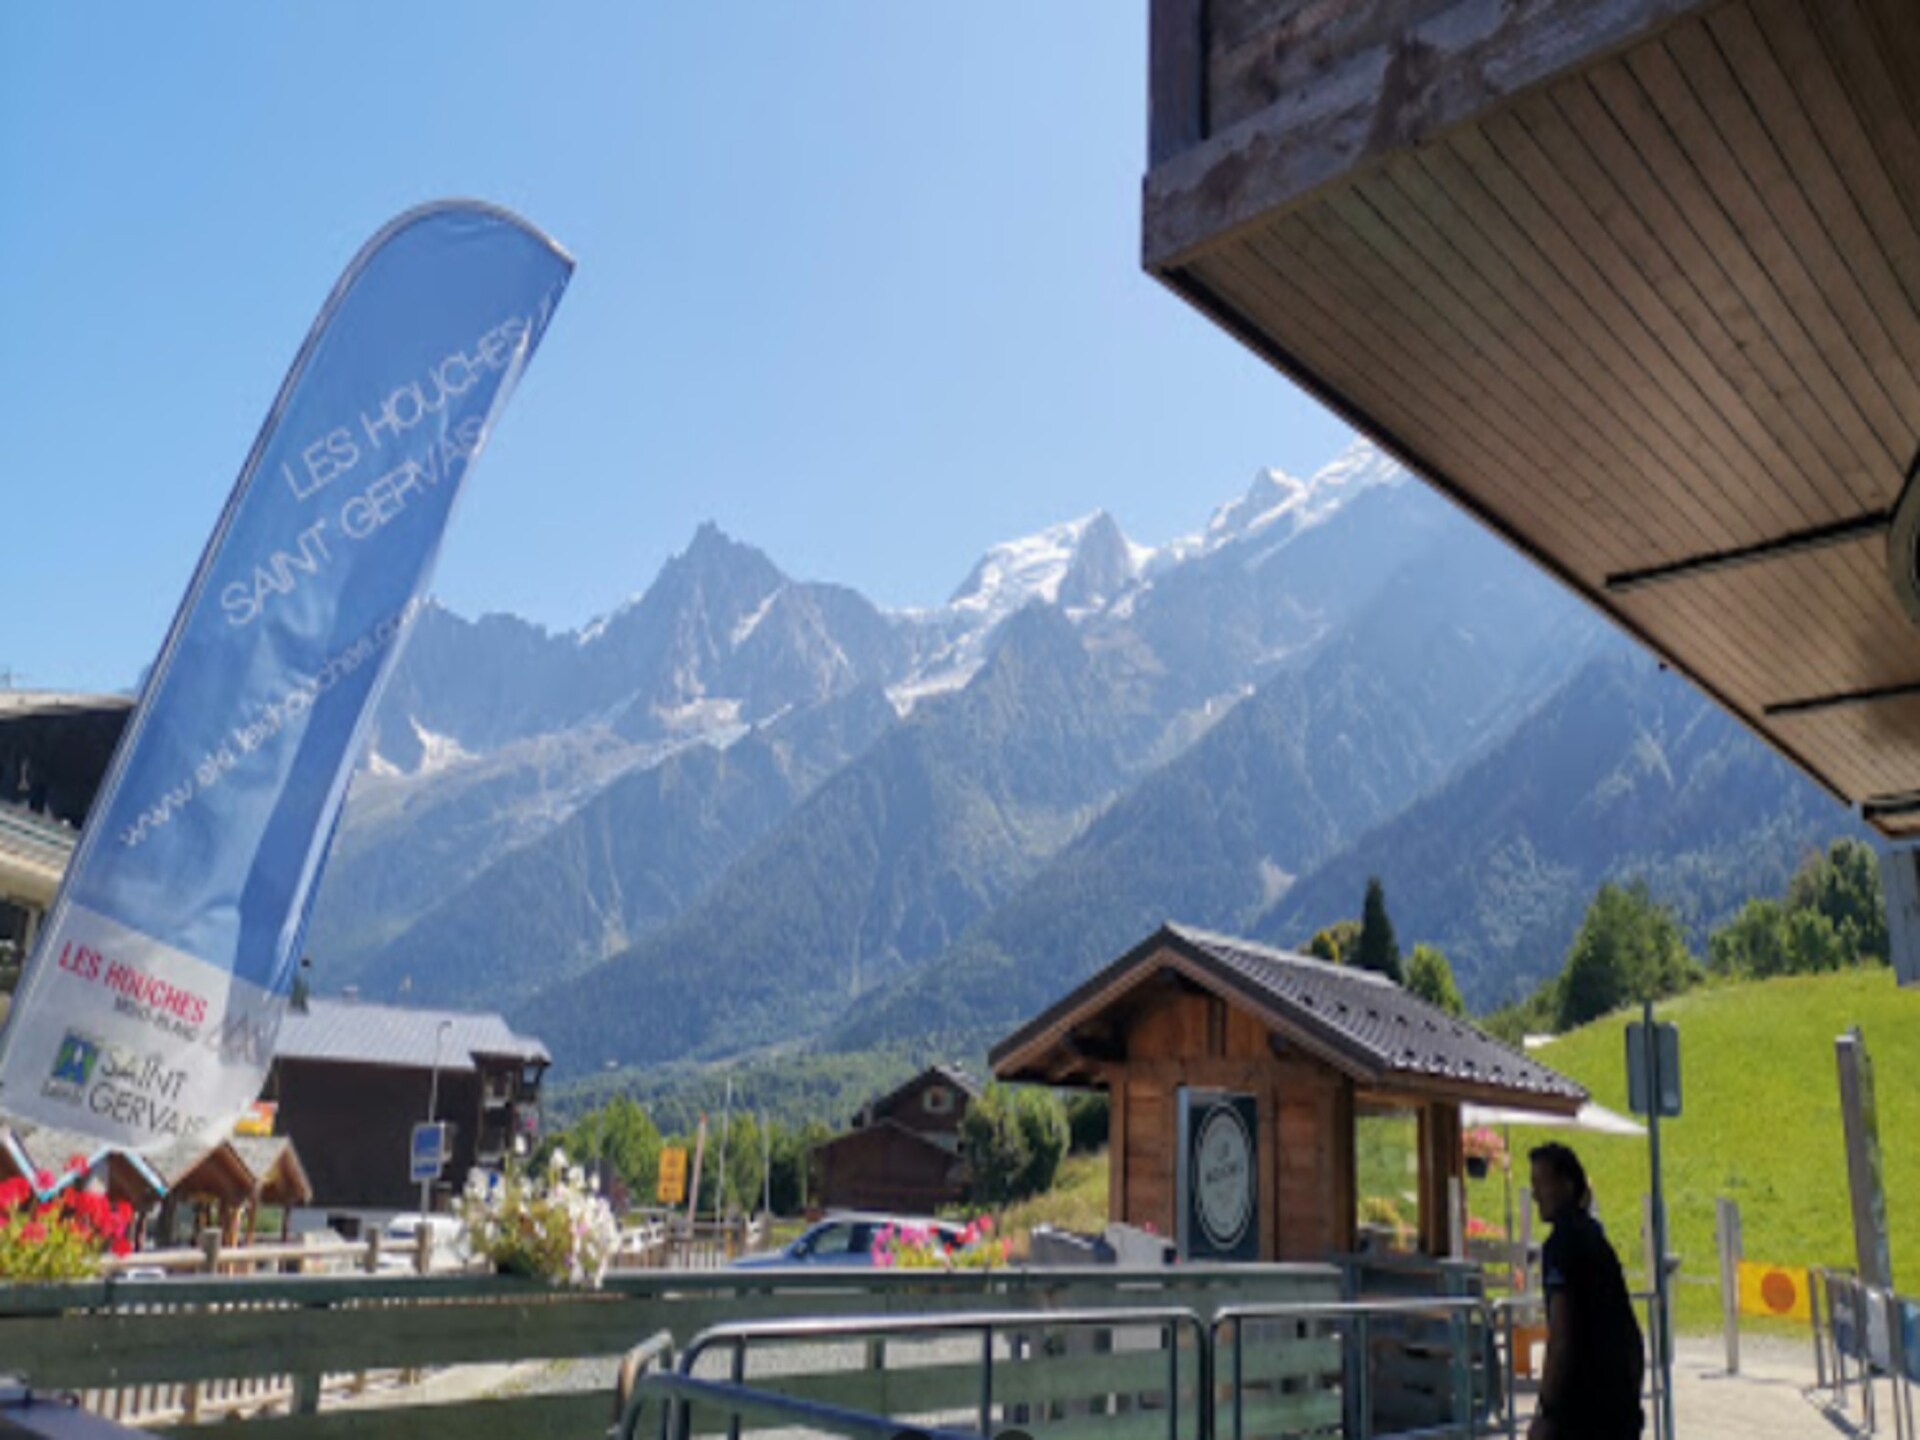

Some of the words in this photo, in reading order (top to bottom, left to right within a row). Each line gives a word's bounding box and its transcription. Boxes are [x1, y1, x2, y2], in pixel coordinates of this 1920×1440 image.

[281, 427, 359, 500] LES
[220, 518, 331, 627] SAINT
[58, 941, 103, 983] LES
[104, 960, 208, 1024] HOUCHES
[101, 1047, 188, 1100] SAINT
